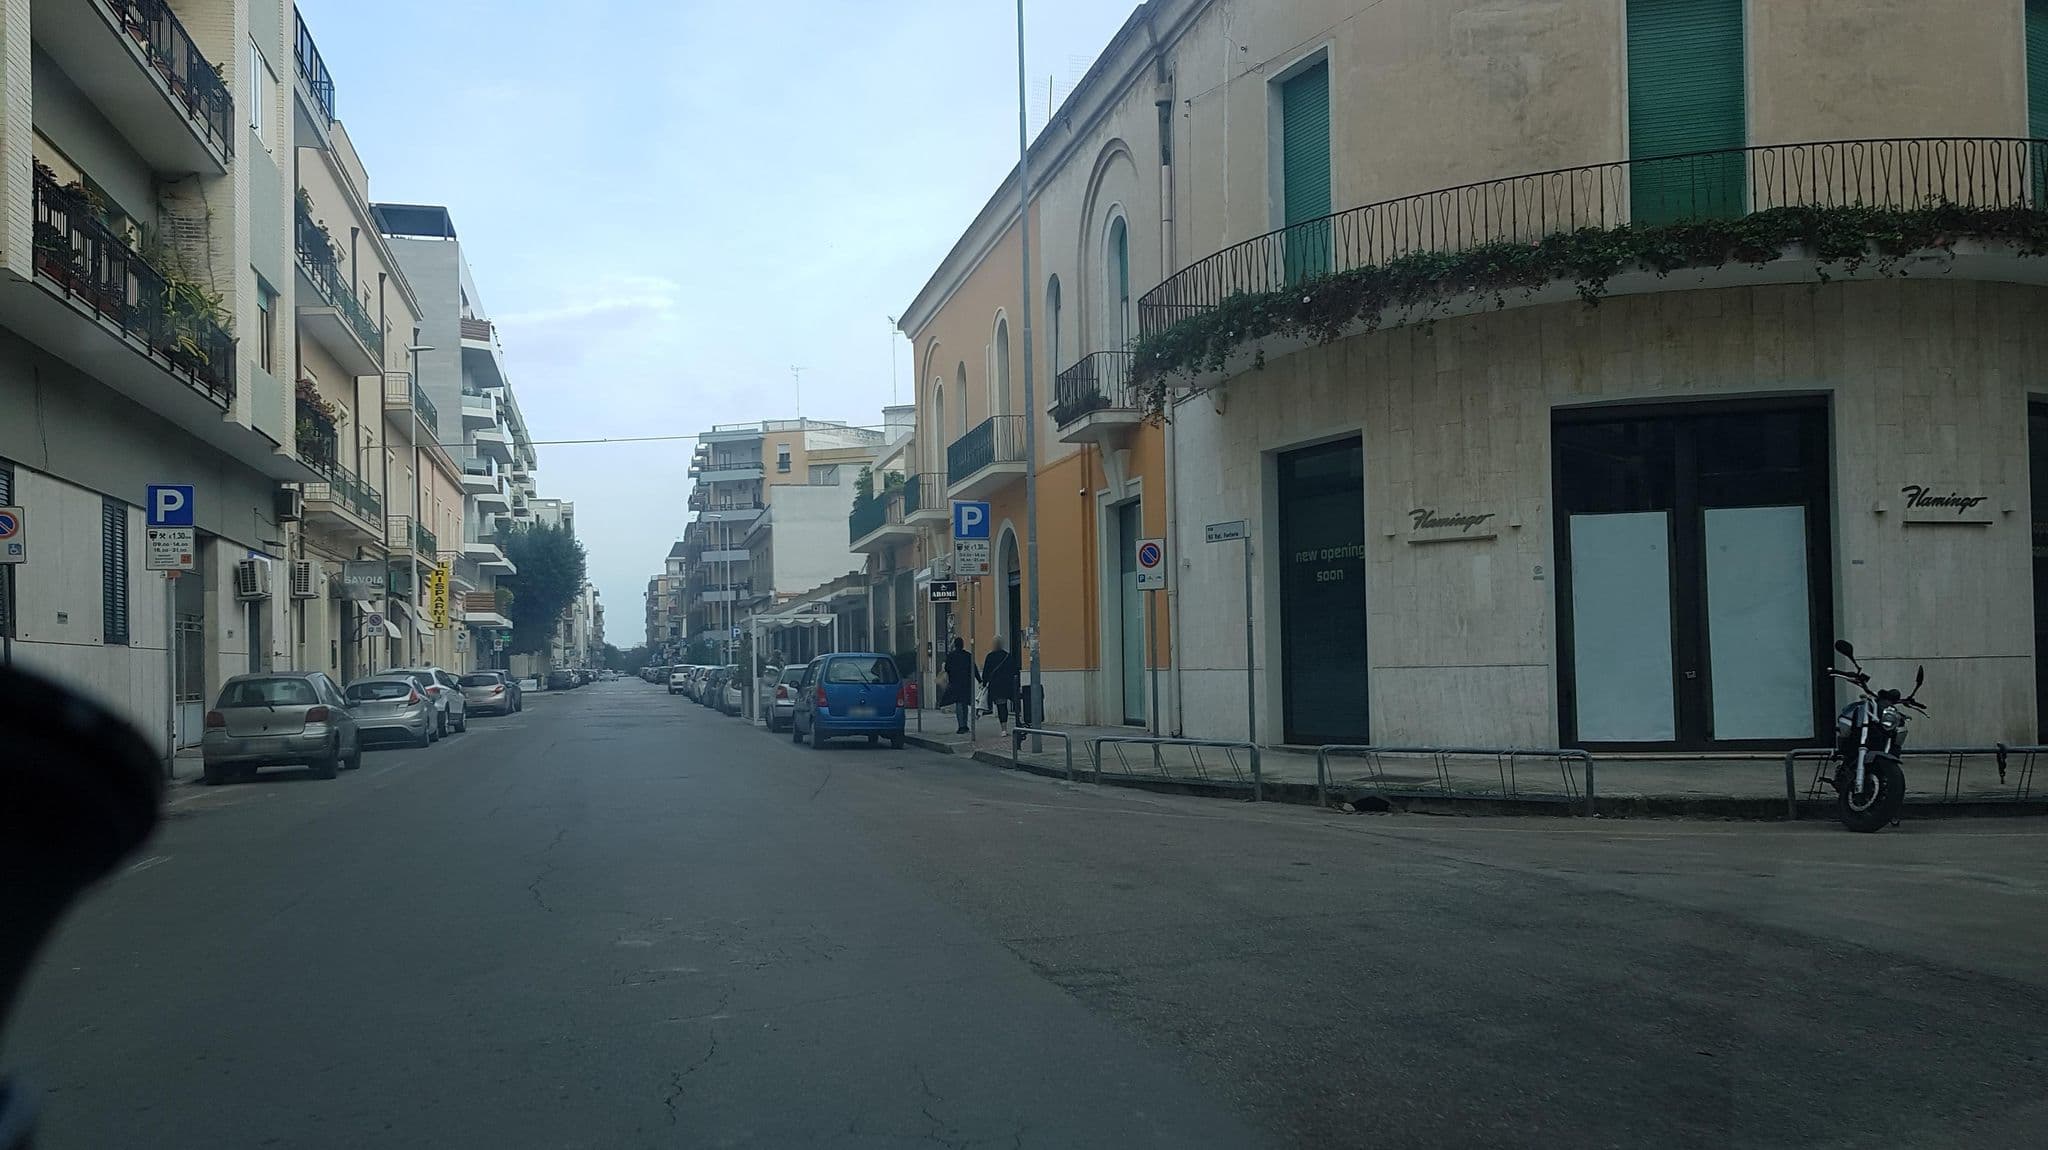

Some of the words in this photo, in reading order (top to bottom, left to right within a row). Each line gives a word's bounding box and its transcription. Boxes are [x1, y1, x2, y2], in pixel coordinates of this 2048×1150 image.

[157, 489, 184, 522] P
[1902, 485, 1988, 515] Flamingo
[962, 506, 983, 535] P
[1408, 508, 1496, 533] Flamingo
[1295, 549, 1318, 563] new
[1321, 542, 1365, 563] opening
[344, 575, 383, 584] SAVOIA
[1316, 569, 1344, 582] soon
[433, 570, 445, 629] RISPARMIO
